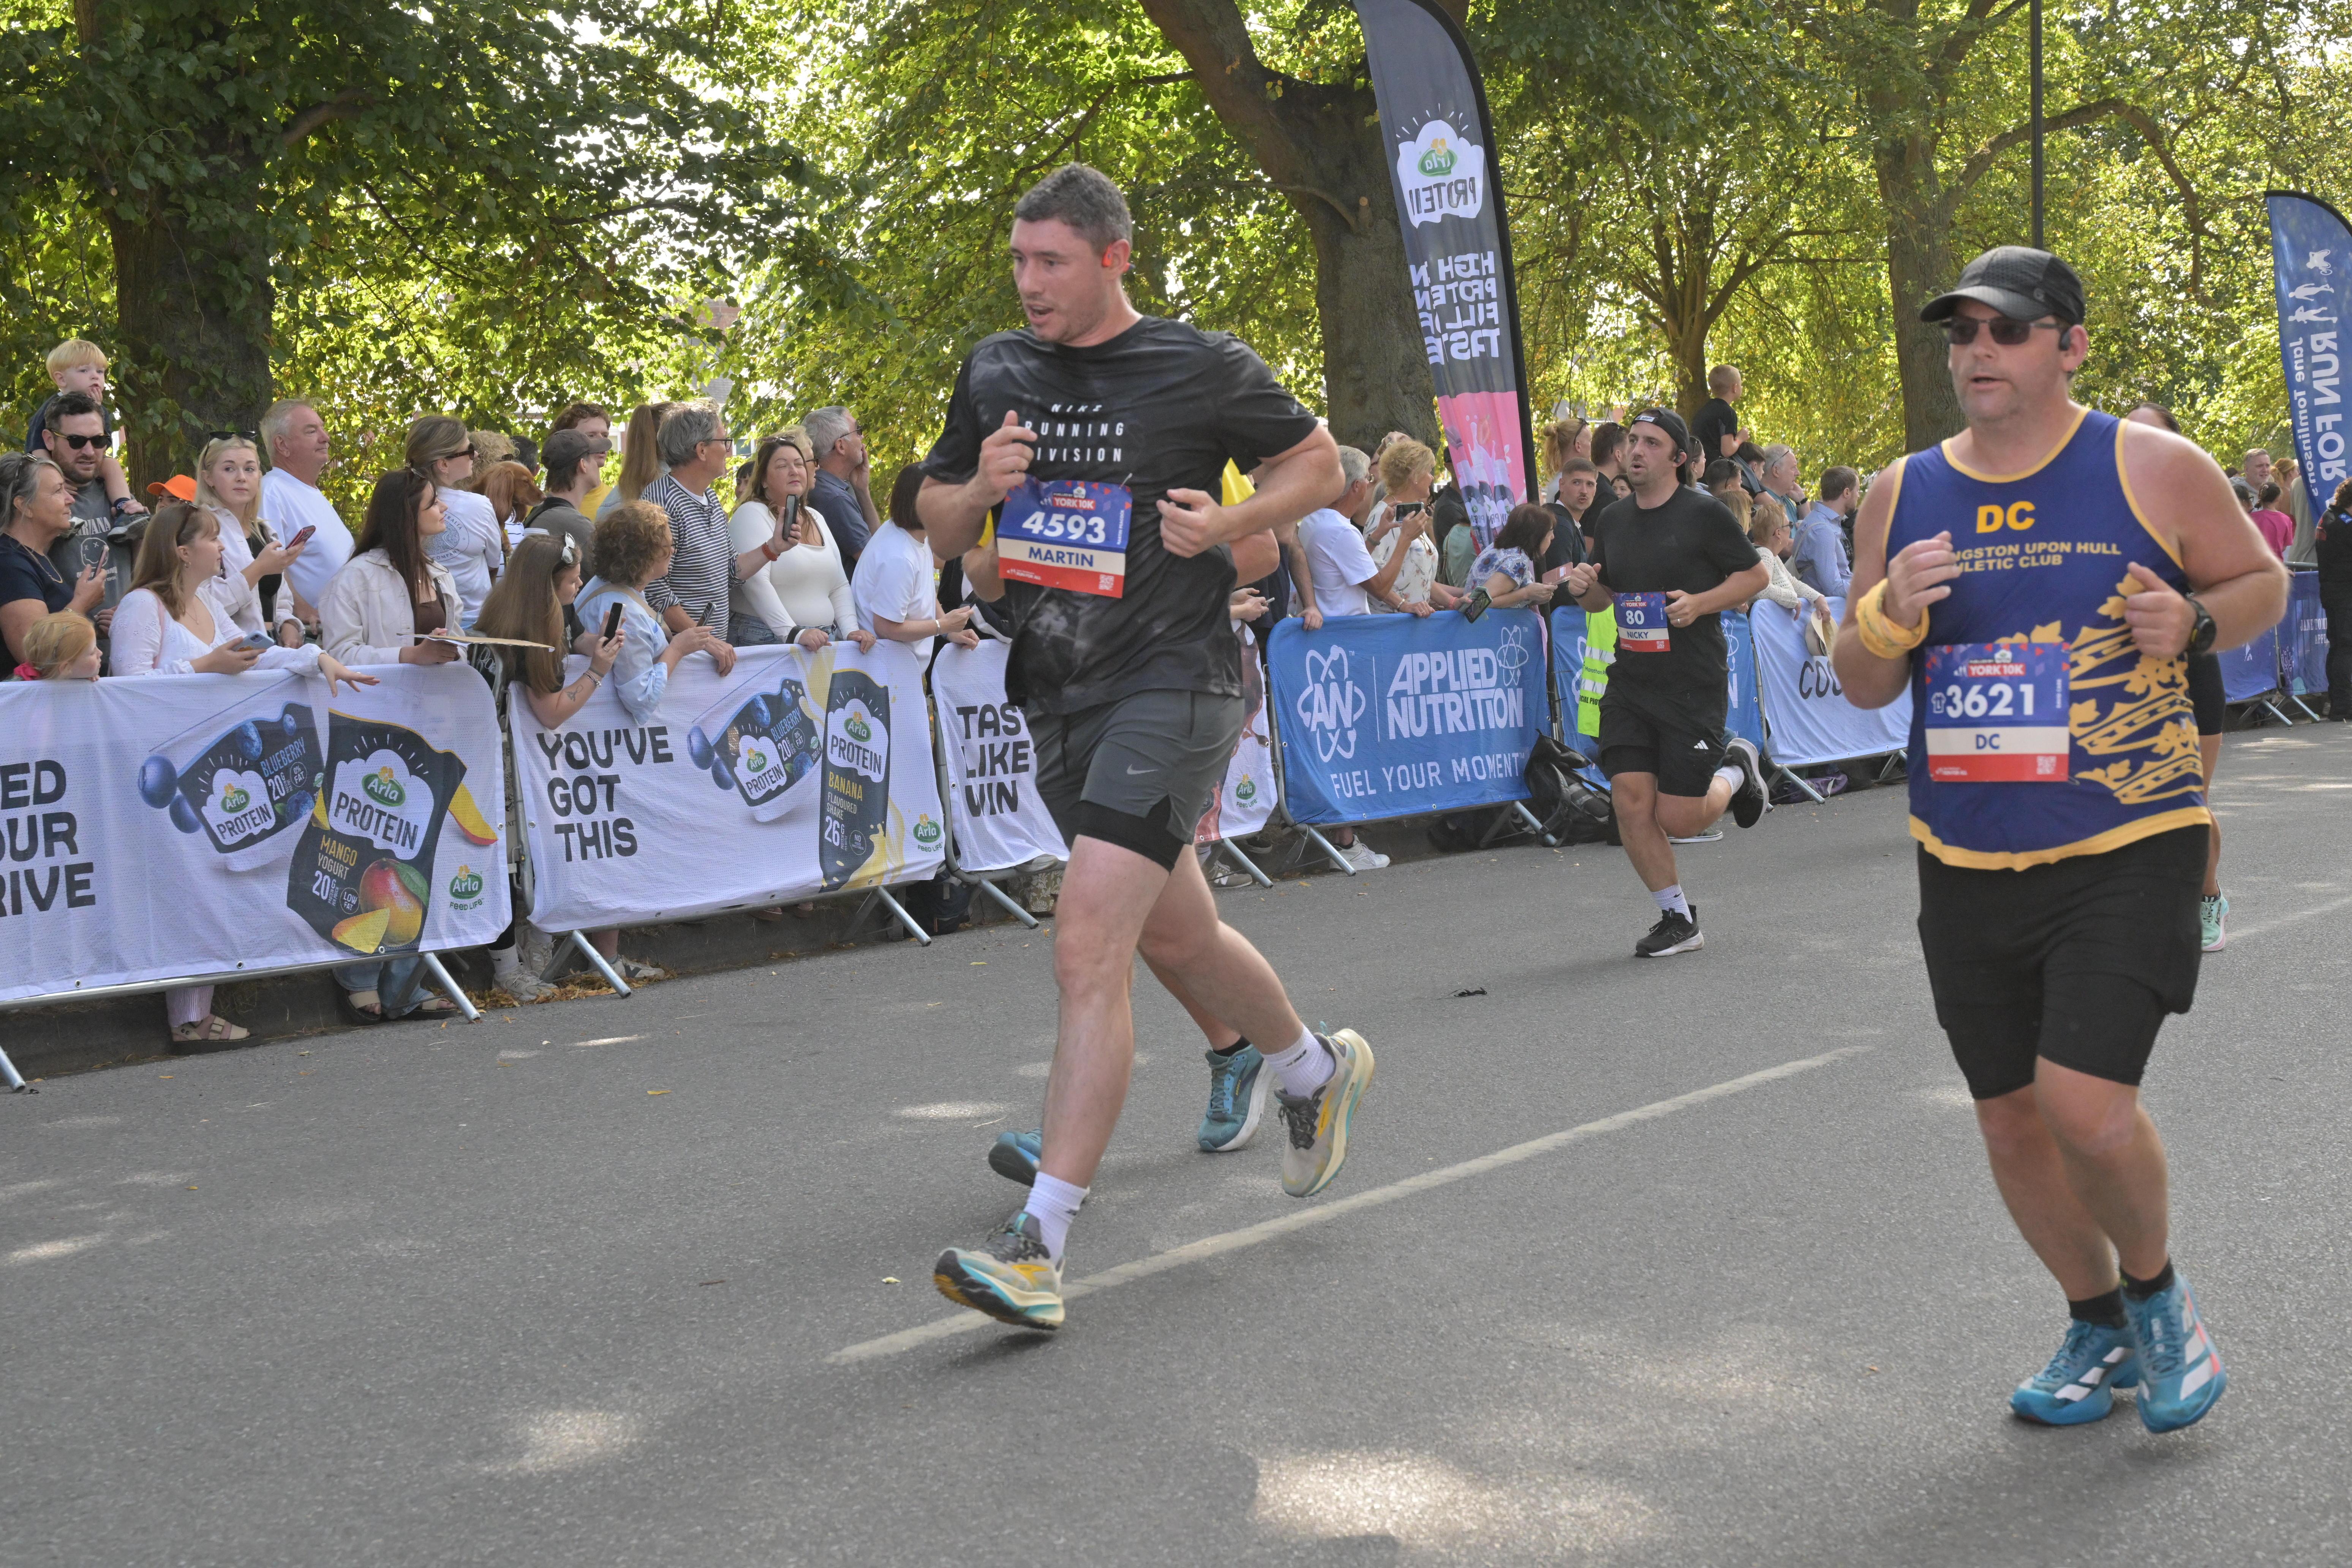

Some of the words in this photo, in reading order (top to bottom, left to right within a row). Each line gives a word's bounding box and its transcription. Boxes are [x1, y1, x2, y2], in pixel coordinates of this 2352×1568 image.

[1051, 404, 1102, 413] NIKE
[1025, 421, 1124, 437] RUNNING
[1037, 447, 1122, 462] IVISION
[1054, 497, 1078, 508] YORK
[1078, 499, 1094, 509] 10K
[76, 517, 111, 536] RVANA
[444, 514, 462, 530] TRALIA
[1022, 510, 1106, 544] 4593
[1976, 501, 2036, 534] DC
[1029, 547, 1093, 567] MARTIN
[1955, 544, 2020, 561] NGSTON
[2025, 542, 2072, 554] UPON
[2076, 542, 2122, 555] HULL
[1957, 558, 2014, 572] LETIC
[2019, 554, 2063, 567] CLUB
[1626, 610, 1644, 625] 80
[2300, 619, 2314, 631] JANE
[2315, 634, 2328, 645] APPE
[1387, 648, 1497, 697] APPLIED
[1585, 666, 1602, 675] Marathon
[1970, 664, 2001, 675] YORK
[2003, 664, 2024, 675] 10K
[1946, 683, 2034, 718] 3621
[956, 702, 1021, 739] TAS
[1387, 688, 1523, 740] NUTRITION
[770, 707, 802, 742] BLUEBERRY
[848, 721, 867, 738] Arla
[536, 726, 674, 770] YOU'VE
[1976, 733, 2000, 750] DC
[260, 737, 306, 777] BLUEBERRY
[750, 755, 764, 770] Arla
[830, 735, 881, 775] PROTEIN
[961, 740, 1031, 778] LIKE
[294, 771, 305, 784] FAT
[746, 763, 784, 795] PROTEIN
[1331, 769, 1376, 798] FUEL
[1382, 761, 1443, 792] YOUR
[1451, 752, 1520, 783] MOMENT
[367, 779, 399, 801] Arla
[547, 774, 621, 817] GOT
[829, 771, 863, 801] BANANA
[1238, 783, 1253, 795] Arla
[225, 792, 246, 809] Arla
[828, 792, 857, 814] FLAVOURED
[965, 780, 1018, 817] WIN
[216, 803, 272, 839] PROTEIN
[334, 792, 418, 850] PROTEIN
[827, 803, 844, 820] SHAKE
[0, 812, 78, 861] UR
[554, 817, 638, 862] THIS
[855, 834, 861, 842] NO
[918, 824, 937, 837] Arla
[320, 835, 358, 866] MANGO
[318, 853, 349, 880] YOGURT
[0, 862, 95, 917] IVE
[453, 879, 479, 893] Arla
[343, 891, 358, 905] LOW
[343, 901, 353, 910] FAT
